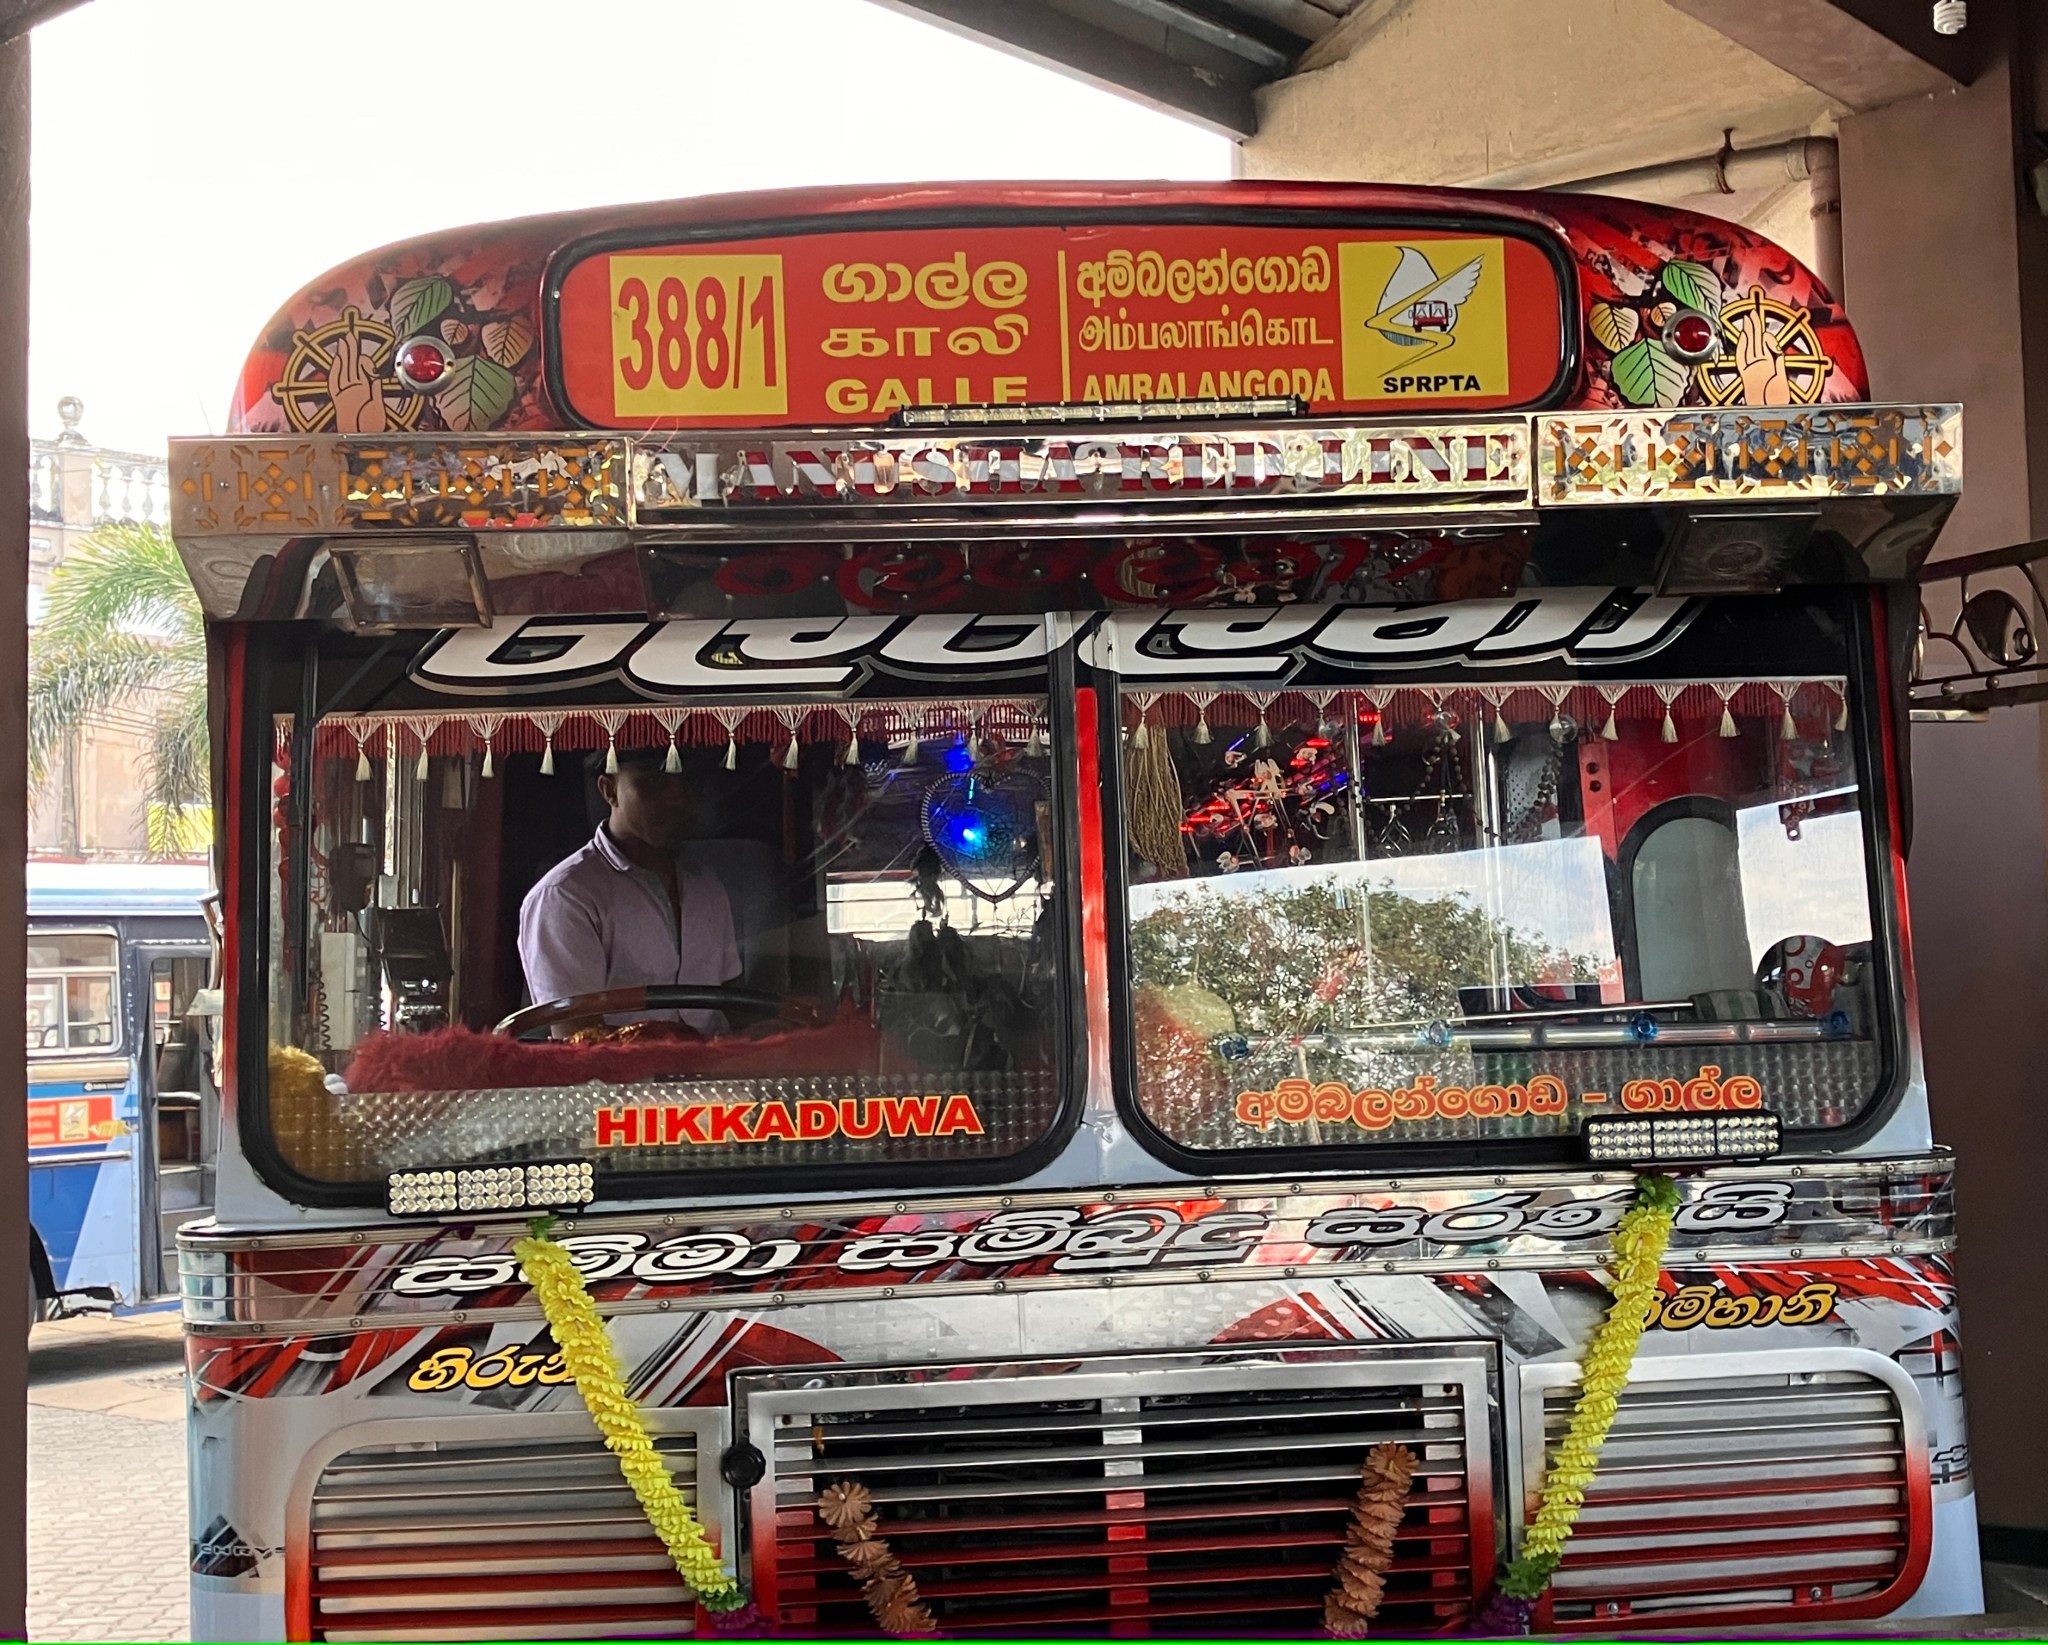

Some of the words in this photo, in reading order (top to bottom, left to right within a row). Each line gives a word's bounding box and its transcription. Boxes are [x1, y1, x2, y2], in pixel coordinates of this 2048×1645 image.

[822, 251, 1028, 309] ගාල්ල
[1076, 245, 1332, 308] අම්බලන්ගොඩ
[618, 275, 776, 390] 388/1
[821, 313, 1029, 358] காலி
[1079, 304, 1334, 352] அம்பலாங்கொட
[825, 376, 1028, 414] GALLE
[1083, 368, 1335, 402] AMBALANGODA
[1383, 375, 1481, 393] SPRPTA
[1315, 434, 1512, 485] LINE
[596, 1095, 985, 1147] HIKKADUWA
[1235, 1074, 1567, 1131] අම්බලන්ගොඩ
[1621, 1065, 1762, 1113] ගාල්ල
